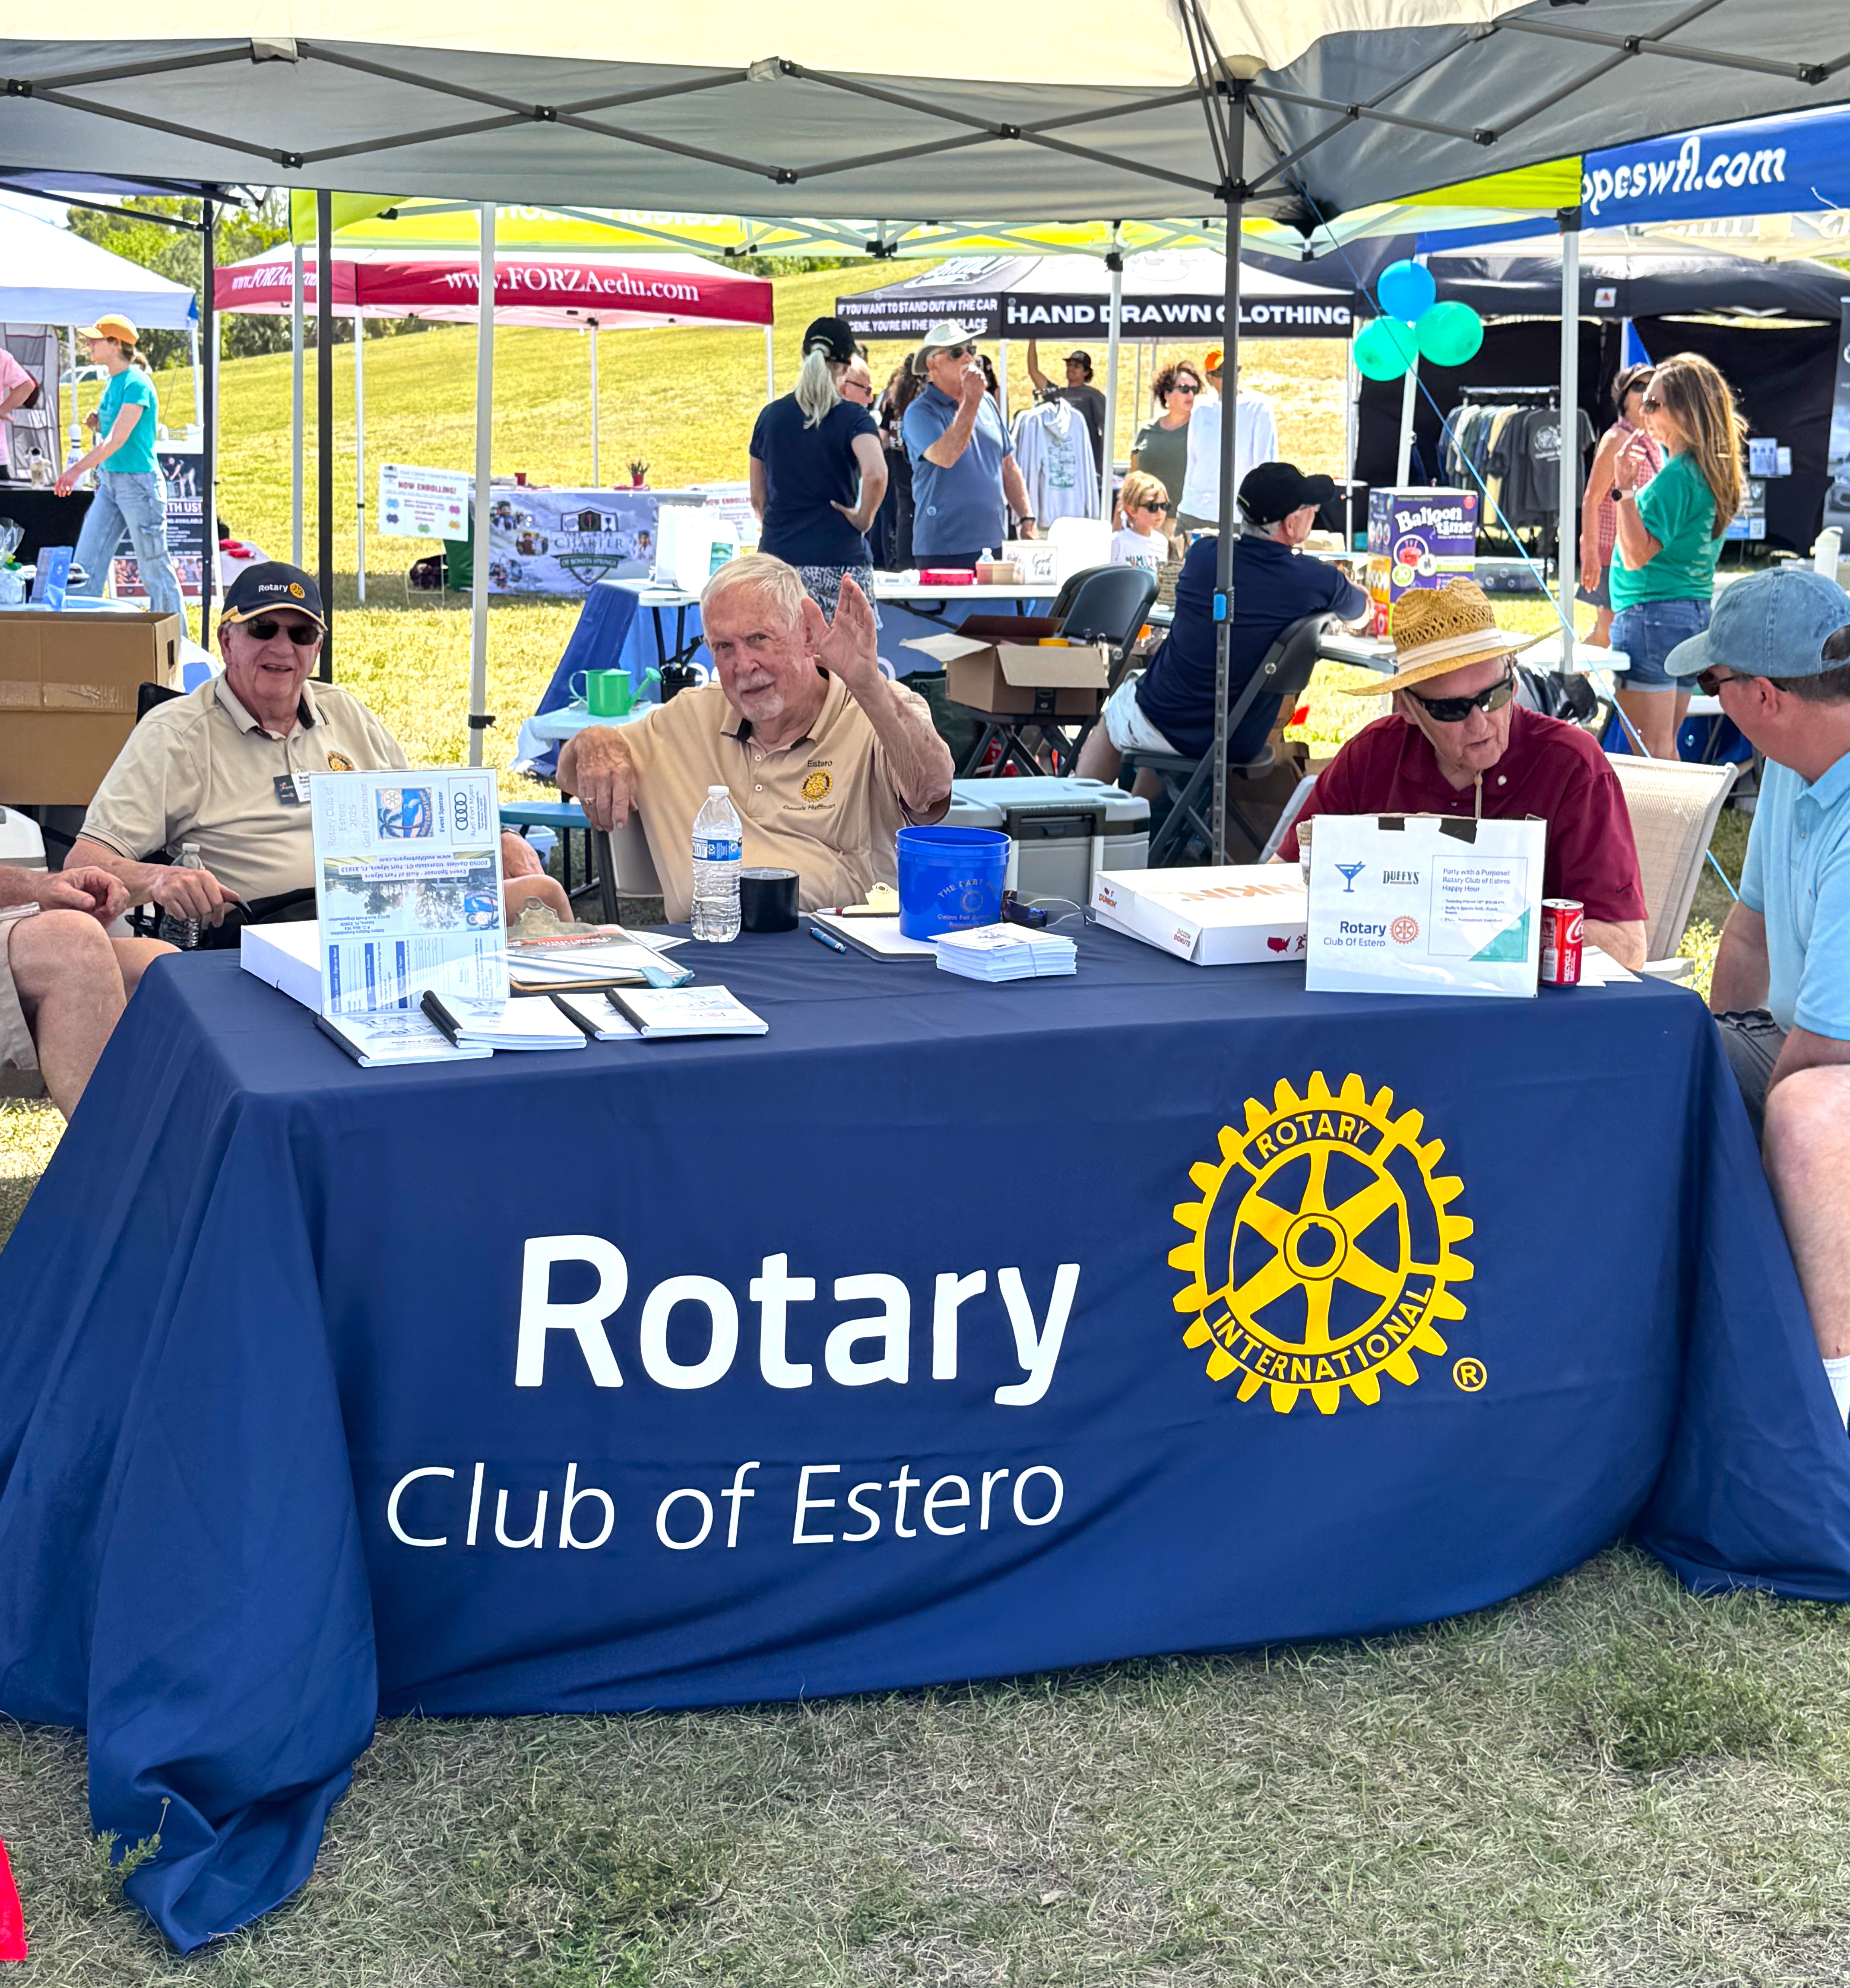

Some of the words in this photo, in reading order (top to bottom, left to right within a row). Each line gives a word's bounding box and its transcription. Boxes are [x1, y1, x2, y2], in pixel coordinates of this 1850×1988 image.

[846, 304, 862, 314] YOU
[862, 303, 886, 314] WANT
[887, 302, 899, 314] TO
[899, 301, 929, 313] STAND
[929, 301, 946, 312] OUT
[957, 300, 976, 311] THE
[976, 299, 998, 311] CAR
[1007, 306, 1095, 324] HAND
[1099, 305, 1211, 323] DRAWN
[911, 319, 928, 331] THE
[184, 502, 202, 513] US!
[1394, 506, 1463, 533] Balloon
[1436, 521, 1474, 535] time
[554, 537, 623, 549] CHARTER
[258, 583, 288, 593] Rotary
[807, 759, 833, 767] Estero
[326, 798, 334, 817] Club
[360, 782, 370, 828] Fundraiser
[348, 804, 358, 828] 2025
[328, 819, 336, 847] Rotary
[361, 830, 371, 848] Golf
[937, 884, 957, 898] THE
[1340, 920, 1387, 937] Rotary
[1174, 934, 1191, 948] DONUTS
[1323, 936, 1343, 946] Club
[1346, 938, 1356, 946] Of
[1359, 938, 1386, 947] Estero
[1563, 948, 1571, 982] RECYCLE
[1255, 1112, 1370, 1160] ROTARY
[515, 1235, 1080, 1406] Rotary
[1212, 1286, 1433, 1383] INTERNATIONAL
[388, 1463, 614, 1549] Club
[656, 1462, 760, 1549] of
[793, 1465, 1063, 1544] Estero
